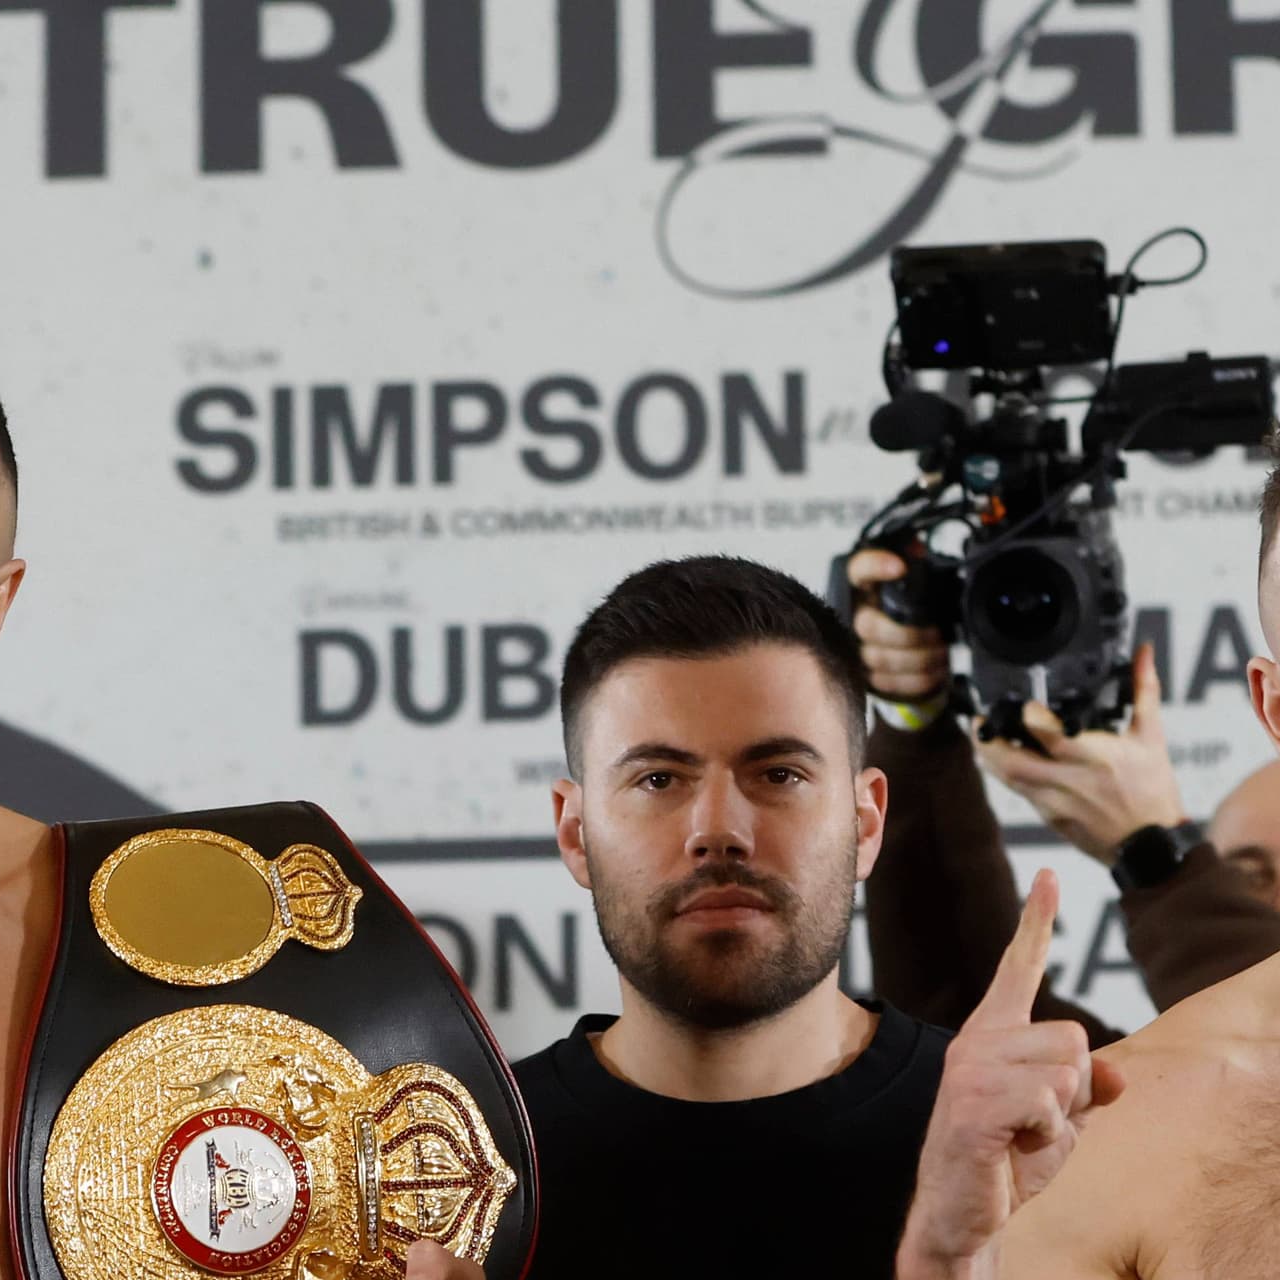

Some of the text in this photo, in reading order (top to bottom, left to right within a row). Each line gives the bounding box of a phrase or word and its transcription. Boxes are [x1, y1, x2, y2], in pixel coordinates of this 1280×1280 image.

[174, 367, 807, 495] SIMPSON
[277, 509, 410, 543] BRITISH
[449, 501, 754, 539] COMMONWEALTH
[201, 1110, 310, 1268] WORLD BOXING ASSOCIATION
